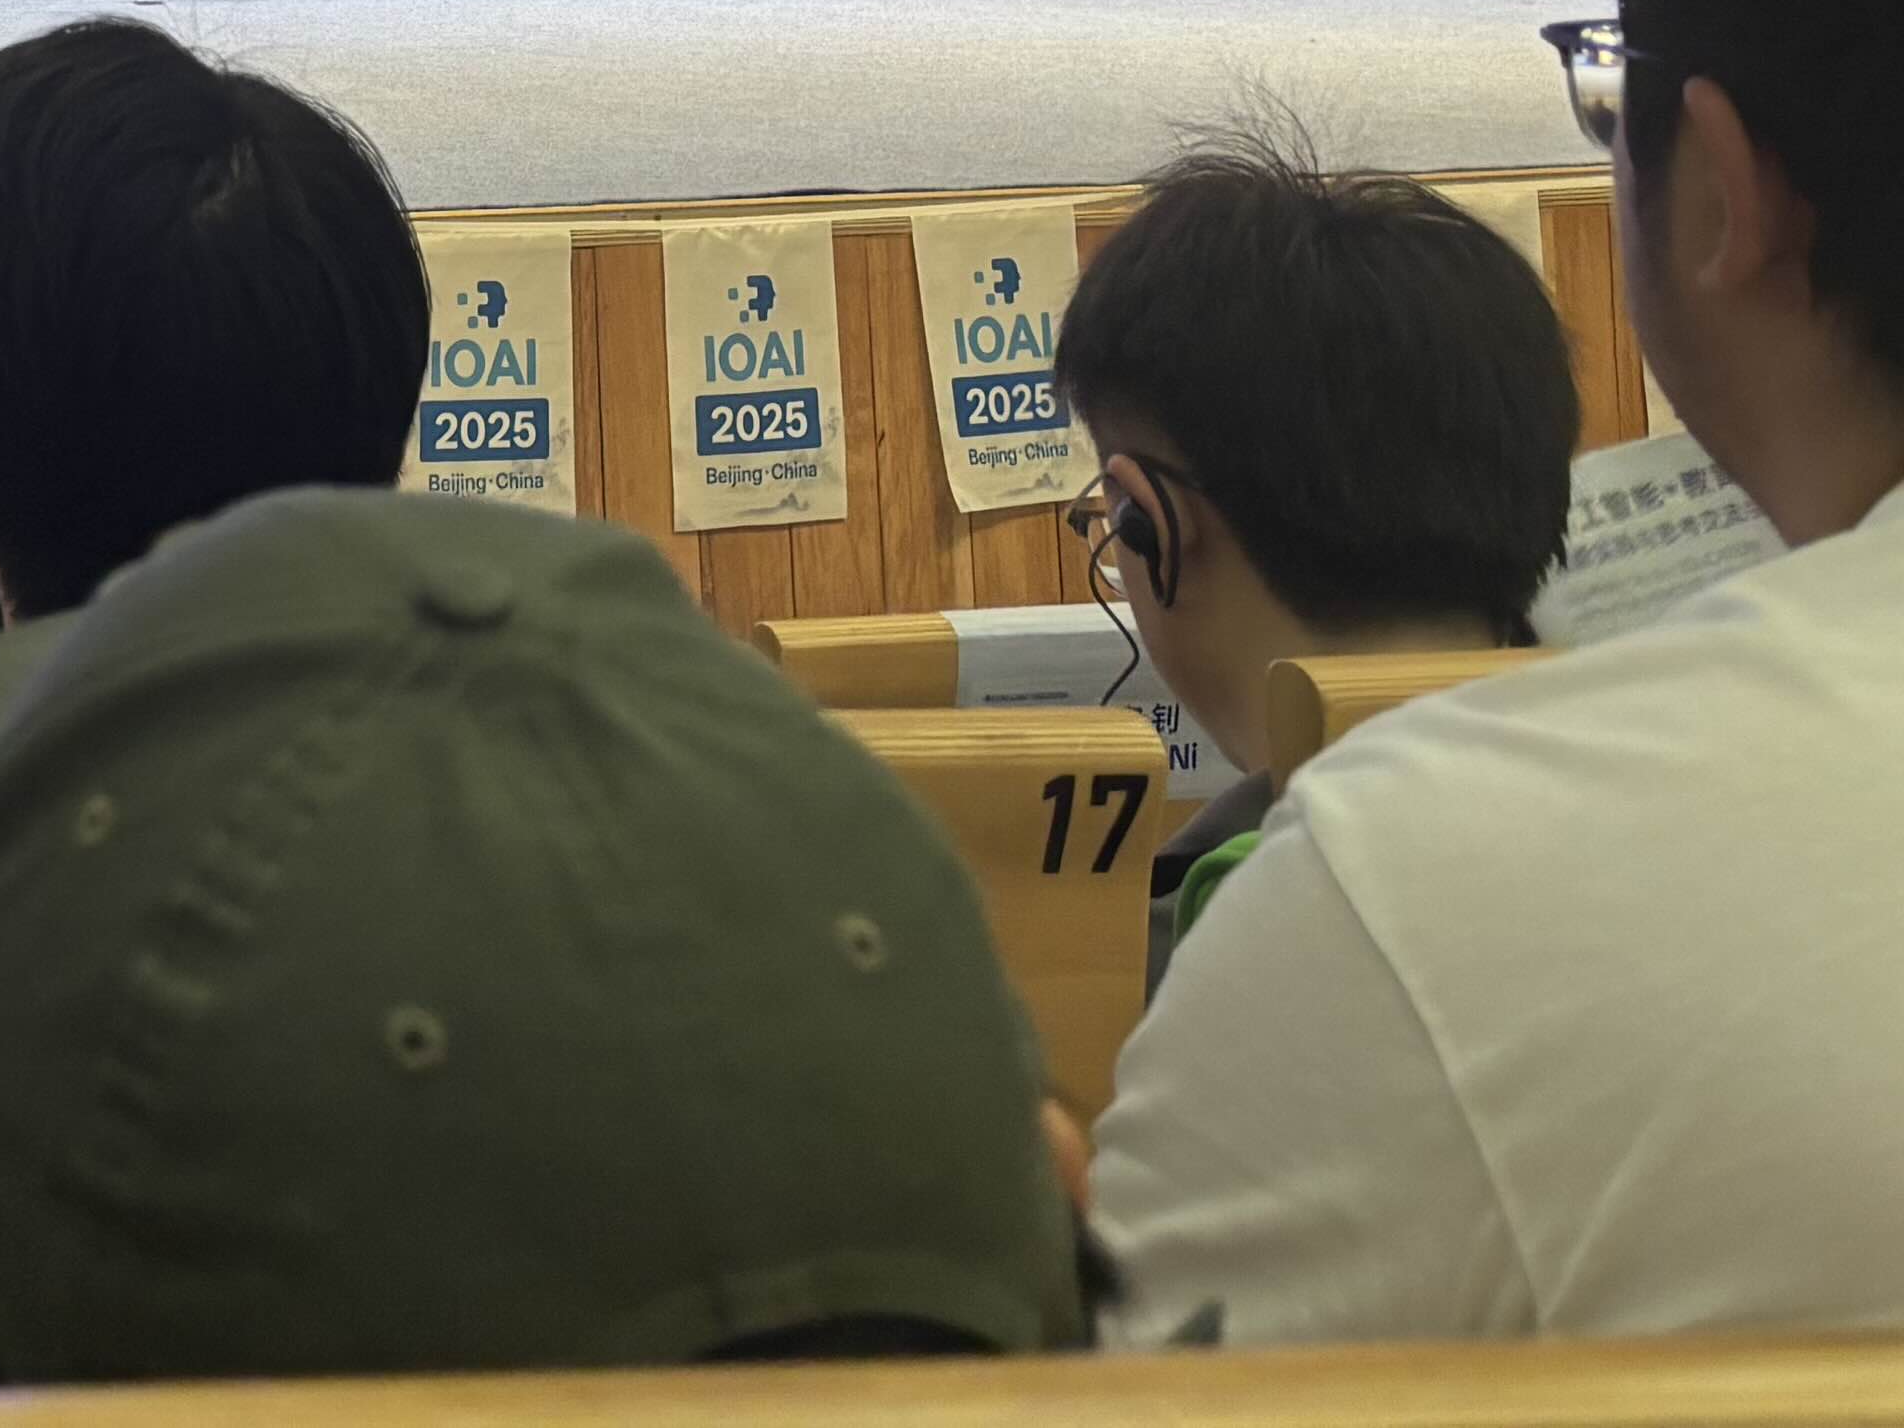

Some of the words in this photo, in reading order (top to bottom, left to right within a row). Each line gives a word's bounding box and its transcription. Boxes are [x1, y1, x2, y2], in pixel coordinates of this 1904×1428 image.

[703, 329, 806, 383] IOAI
[954, 311, 1055, 365] IOAI
[430, 337, 537, 388] IOAI
[710, 400, 809, 445] 2025
[964, 381, 1057, 426] 2025
[434, 409, 537, 451] 2025
[1169, 741, 1198, 771] Ni
[1041, 773, 1149, 875] 17
